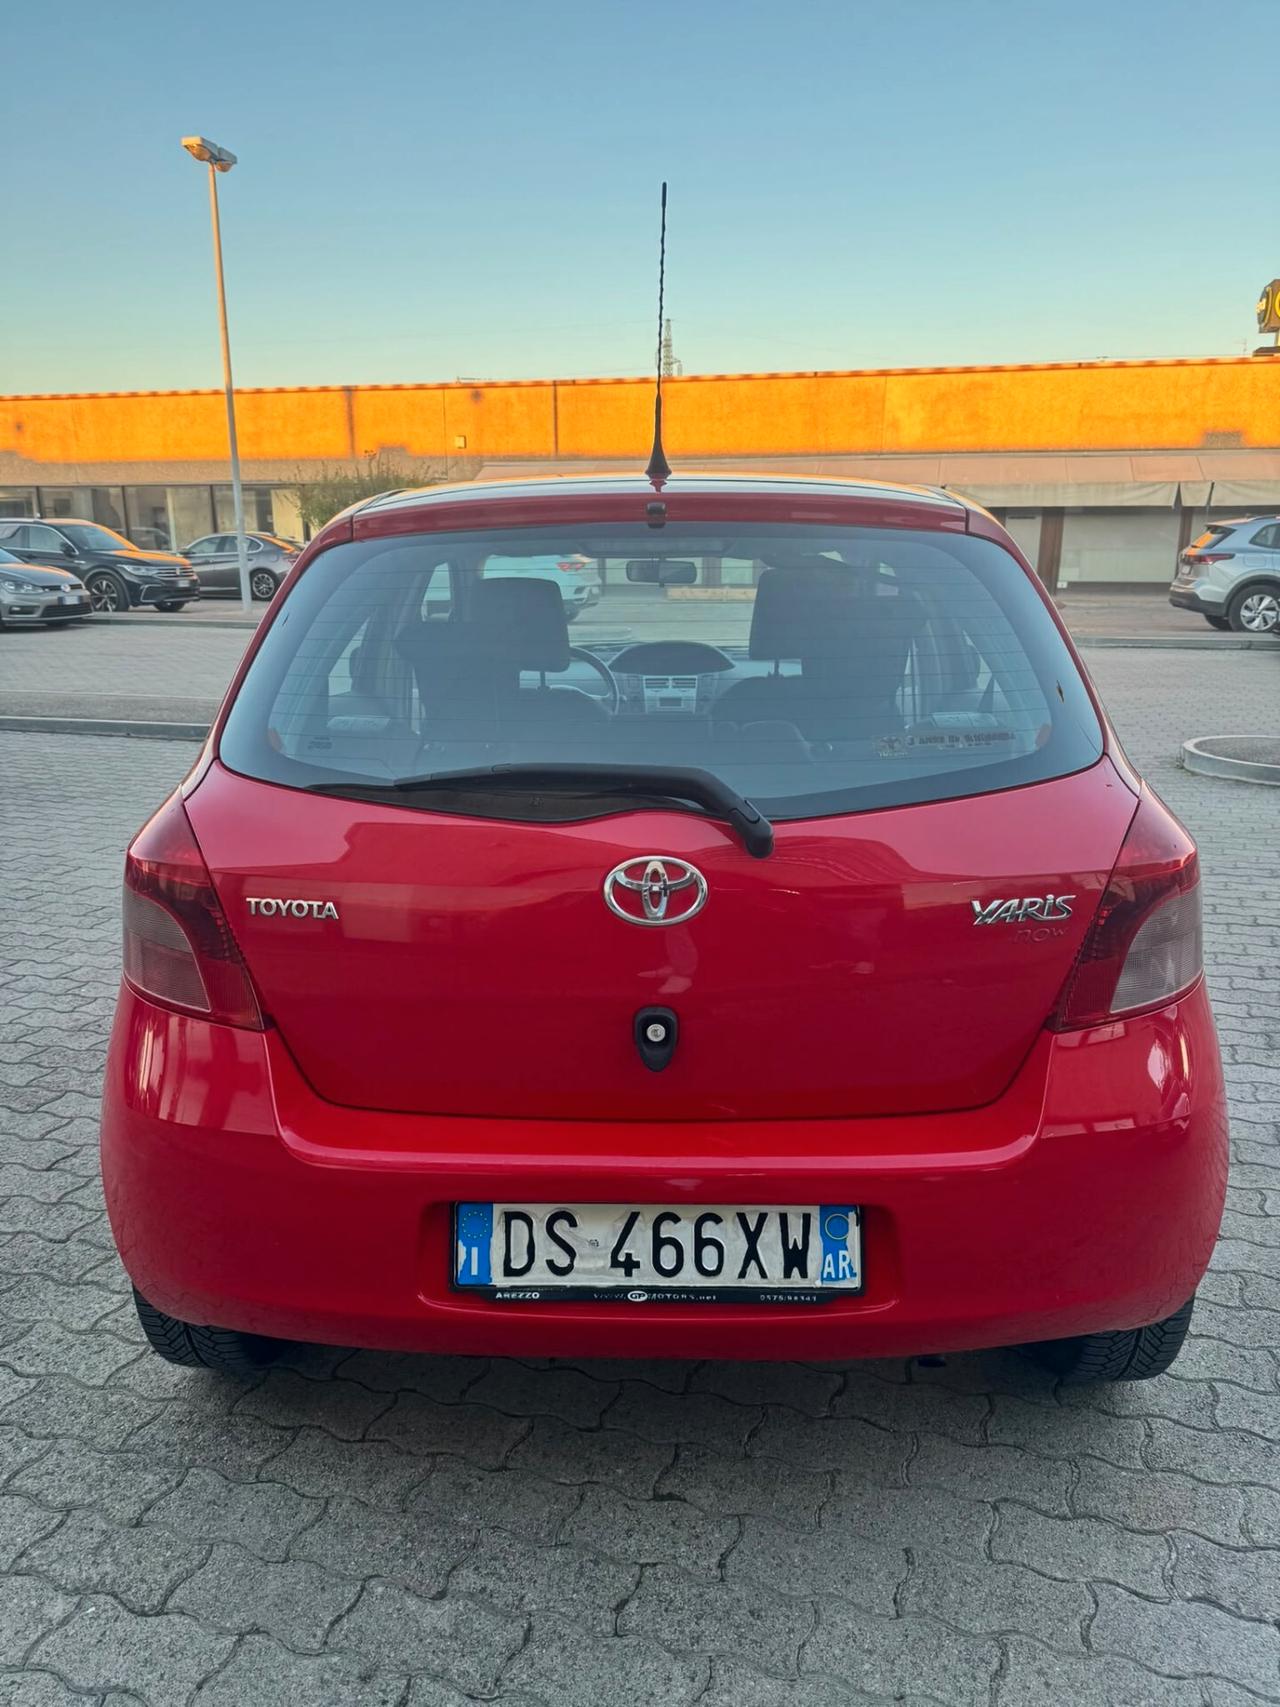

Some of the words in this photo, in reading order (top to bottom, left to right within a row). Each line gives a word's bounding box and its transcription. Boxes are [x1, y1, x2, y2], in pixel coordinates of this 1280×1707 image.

[246, 897, 339, 919] TOYOTA
[503, 1210, 577, 1277] DS
[471, 1247, 478, 1276] I
[823, 1250, 851, 1279] AR
